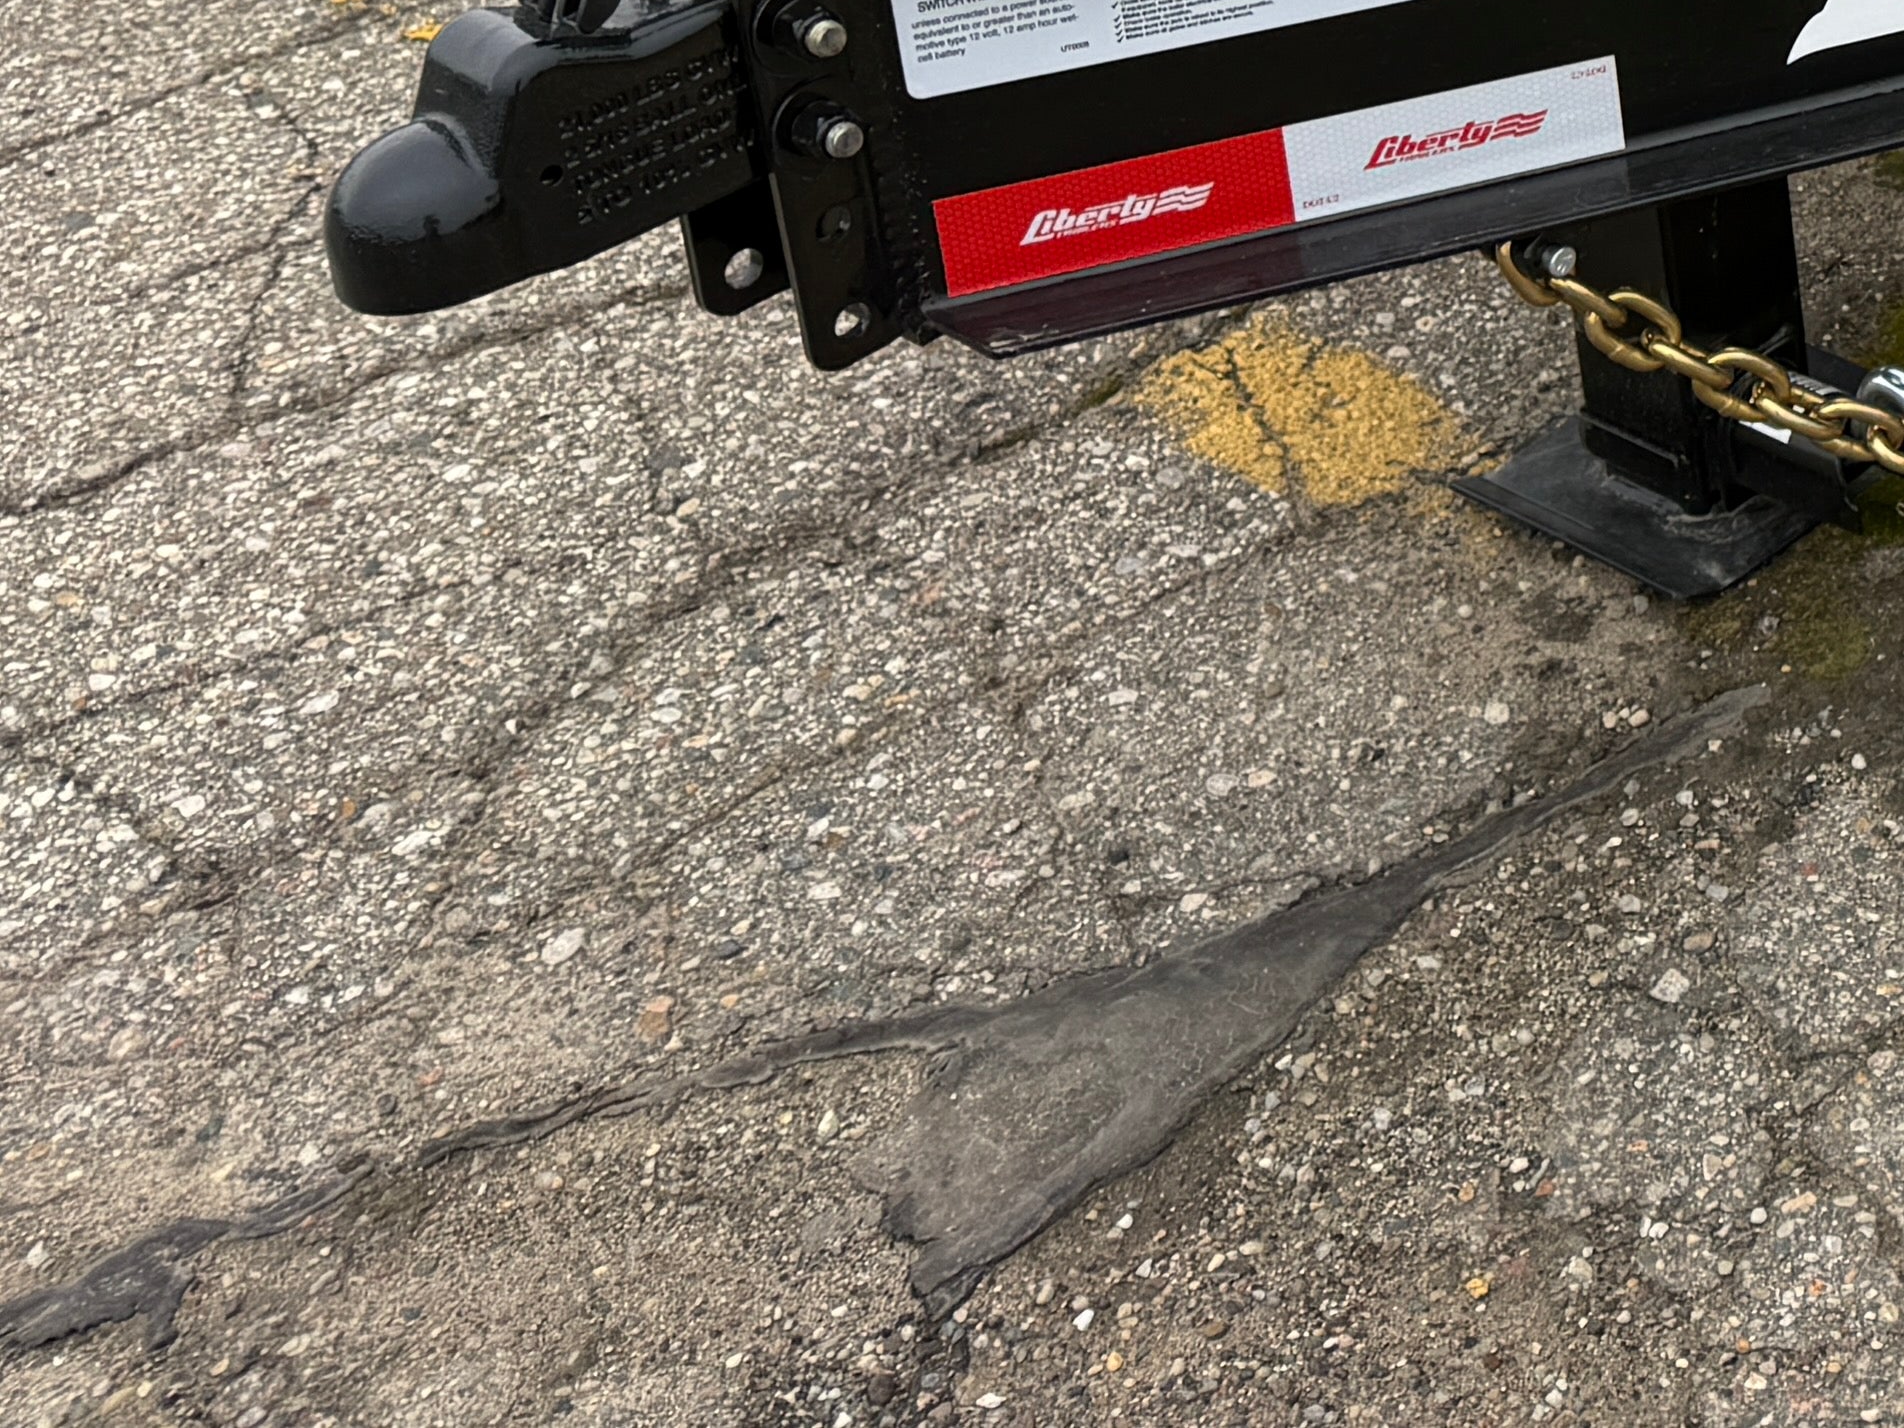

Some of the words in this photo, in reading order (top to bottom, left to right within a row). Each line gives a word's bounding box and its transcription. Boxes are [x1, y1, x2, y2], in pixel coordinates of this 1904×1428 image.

[911, 15, 942, 30] unless
[943, 6, 990, 25] connected
[913, 24, 959, 42] equivalent
[983, 13, 1015, 30] greater
[1017, 9, 1037, 22] than
[915, 37, 946, 52] motive
[947, 33, 967, 49] type
[969, 31, 980, 41] 12
[1003, 24, 1014, 34] 12
[1016, 20, 1036, 34] amp
[1037, 15, 1058, 29] hour
[934, 46, 966, 61] battery
[1363, 120, 1494, 171] Liberty
[1019, 193, 1158, 246] Liberty
